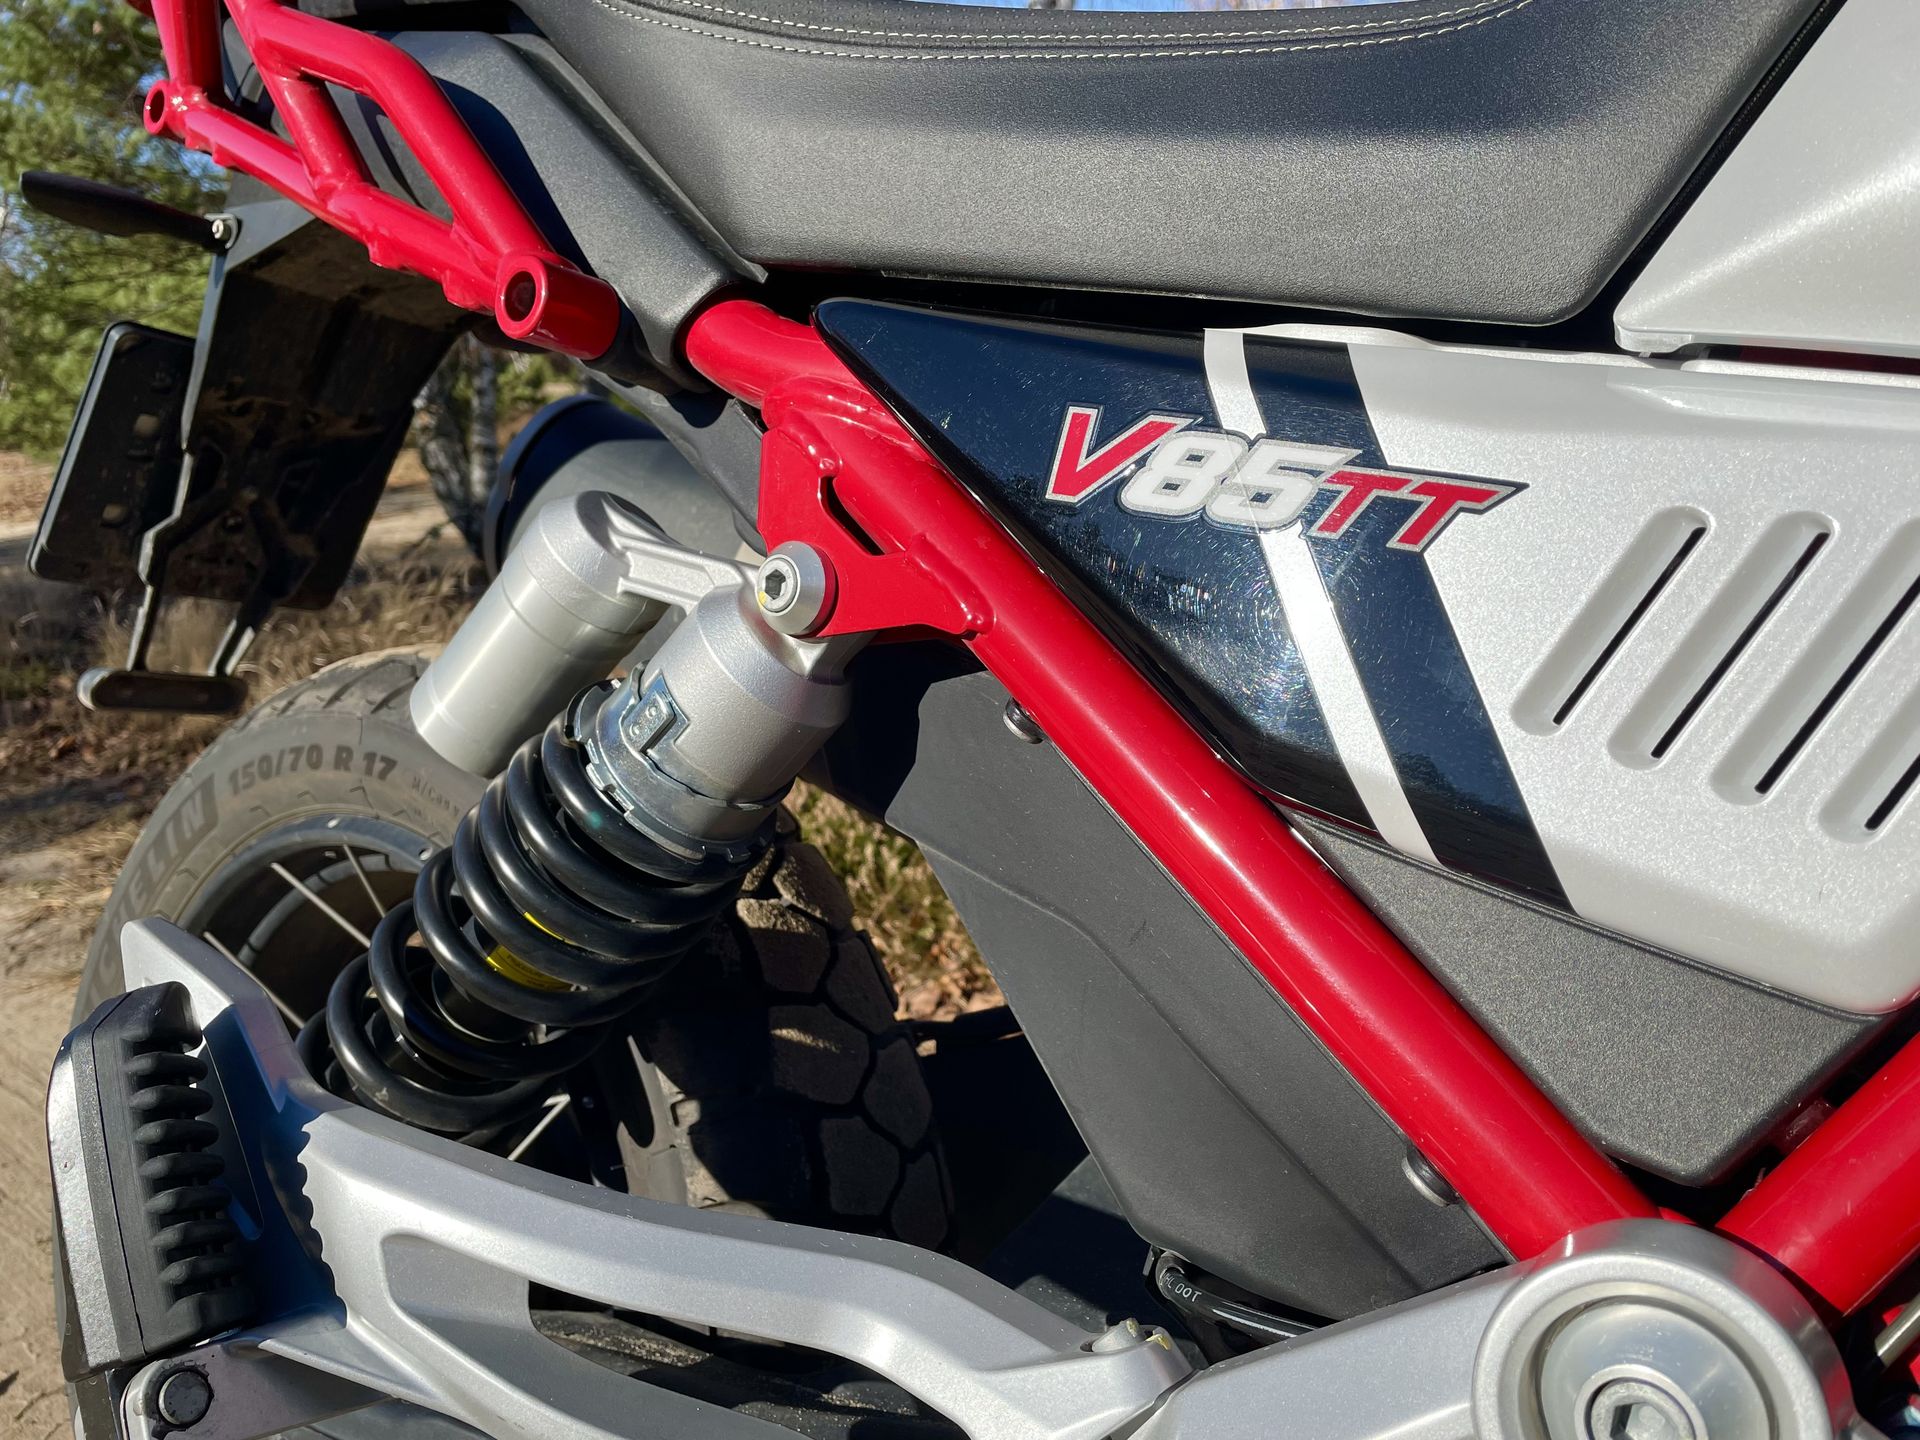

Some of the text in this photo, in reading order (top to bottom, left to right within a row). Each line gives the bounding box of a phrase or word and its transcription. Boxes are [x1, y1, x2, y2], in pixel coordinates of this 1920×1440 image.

[228, 743, 324, 796] 150/70
[333, 744, 355, 772] R
[362, 751, 398, 782] 17
